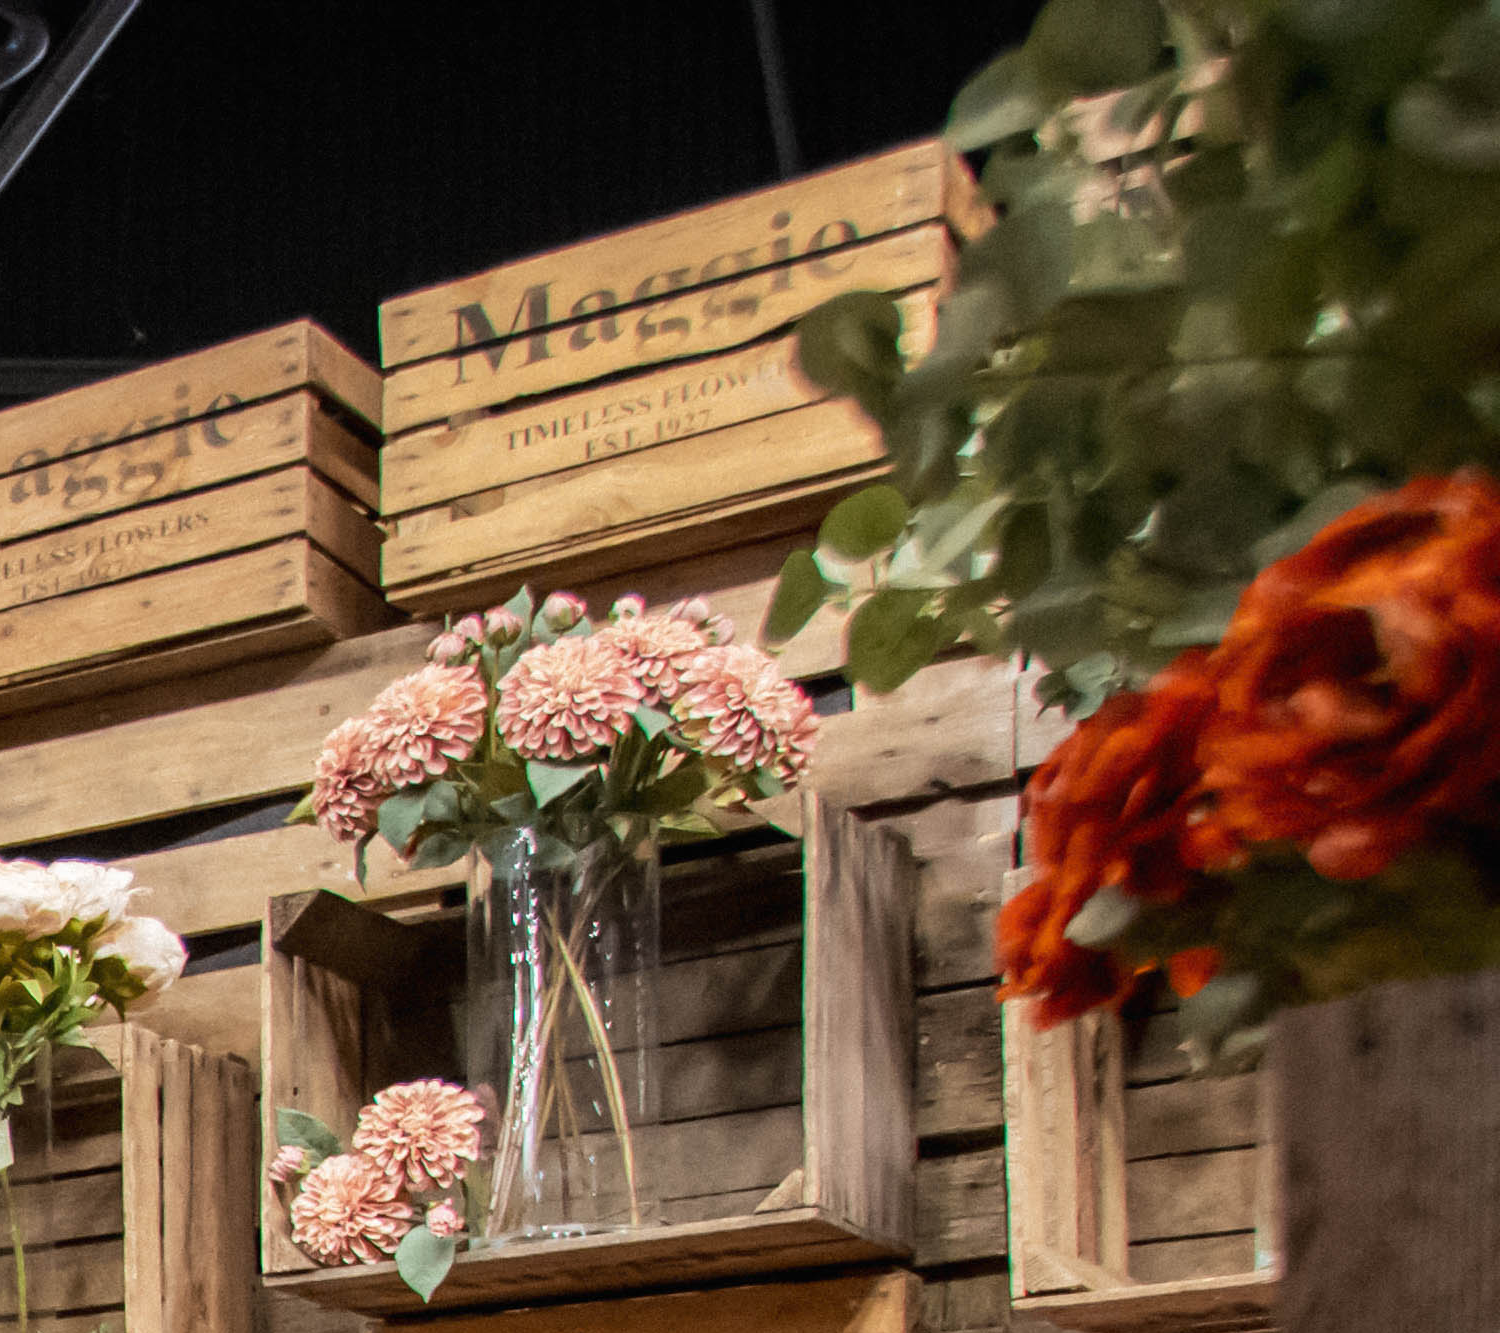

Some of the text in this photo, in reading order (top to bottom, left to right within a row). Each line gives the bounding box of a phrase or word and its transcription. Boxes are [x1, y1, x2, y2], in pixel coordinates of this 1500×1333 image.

[448, 211, 860, 388] Maggie
[507, 396, 652, 450] TIMELESS
[655, 410, 712, 443] 1927
[84, 511, 210, 560] FLOWERS
